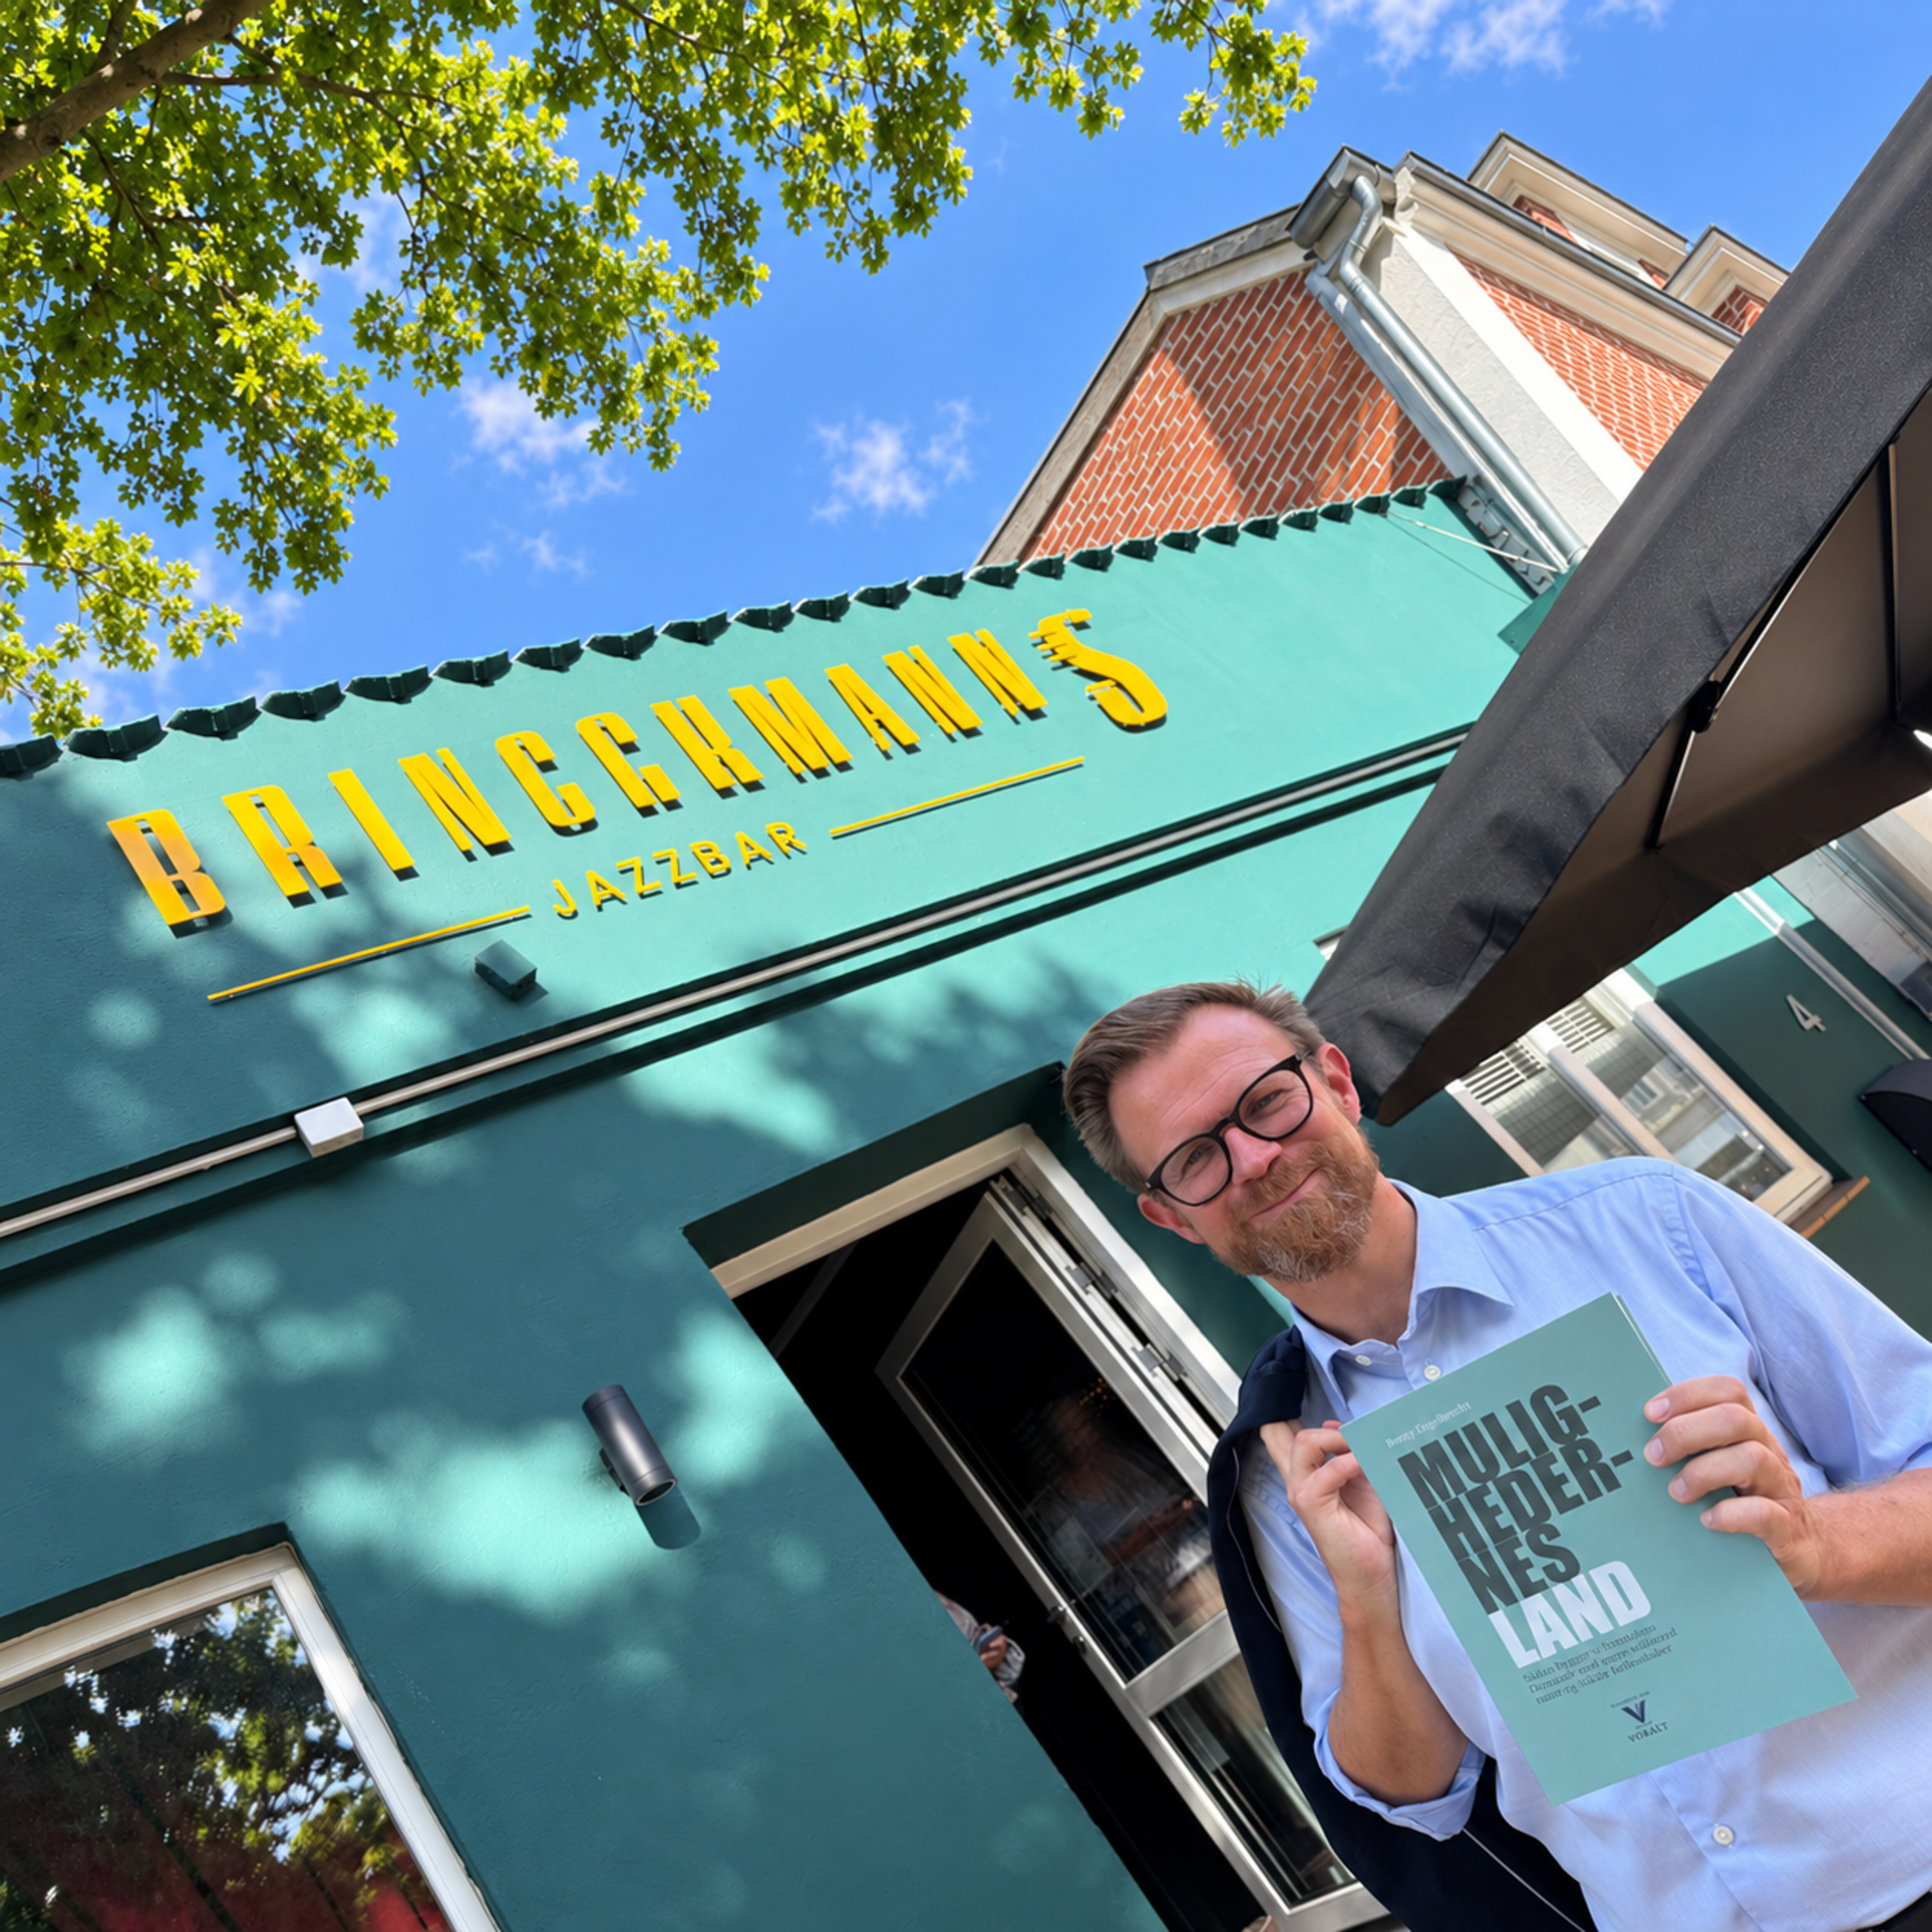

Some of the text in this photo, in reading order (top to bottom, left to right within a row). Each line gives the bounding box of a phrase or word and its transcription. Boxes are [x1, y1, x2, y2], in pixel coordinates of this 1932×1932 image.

[551, 822, 806, 917] JAZZBAR
[1786, 994, 1826, 1032] 4
[1397, 1385, 1602, 1510] MULIG-
[1428, 1437, 1634, 1562] HEDER-
[1458, 1523, 1580, 1615] NES
[1488, 1560, 1651, 1668] LAND
